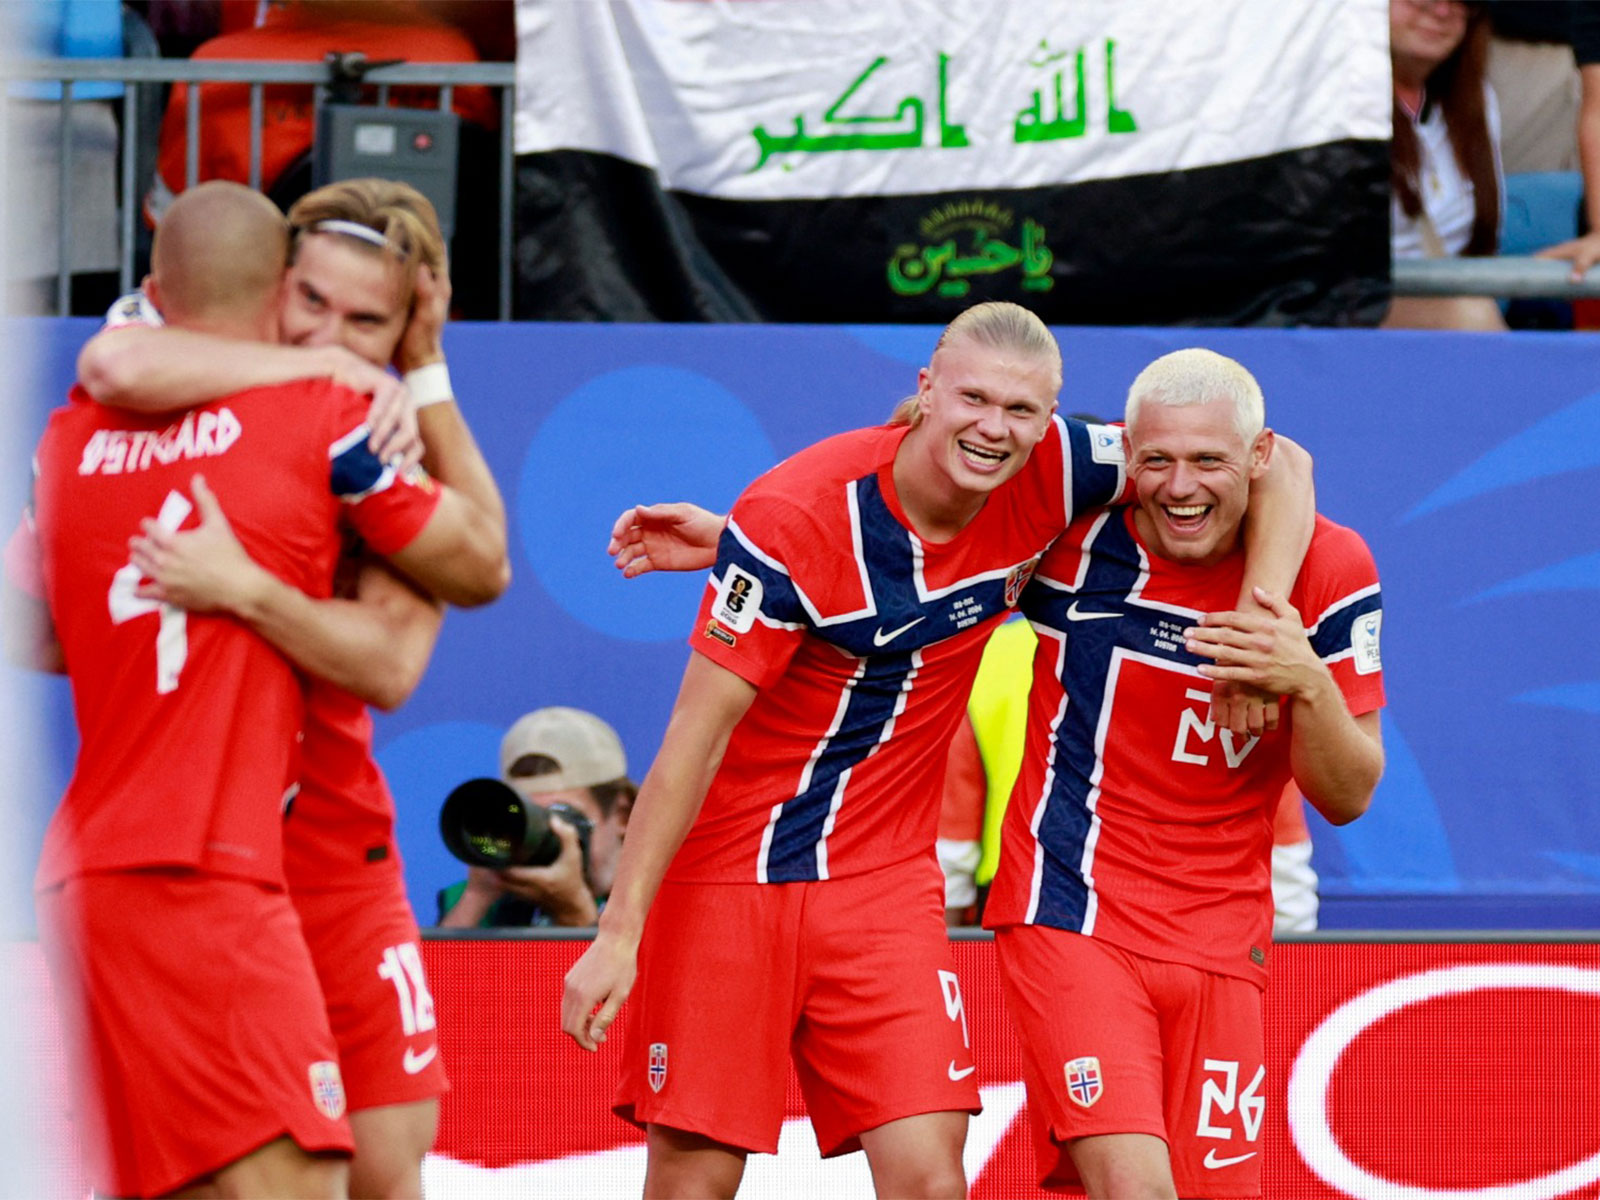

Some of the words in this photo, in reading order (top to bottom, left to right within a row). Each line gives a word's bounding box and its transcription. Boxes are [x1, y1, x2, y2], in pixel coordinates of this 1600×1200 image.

[108, 489, 193, 695] 4
[937, 968, 970, 1049] 9
[1195, 1058, 1267, 1143] 26
